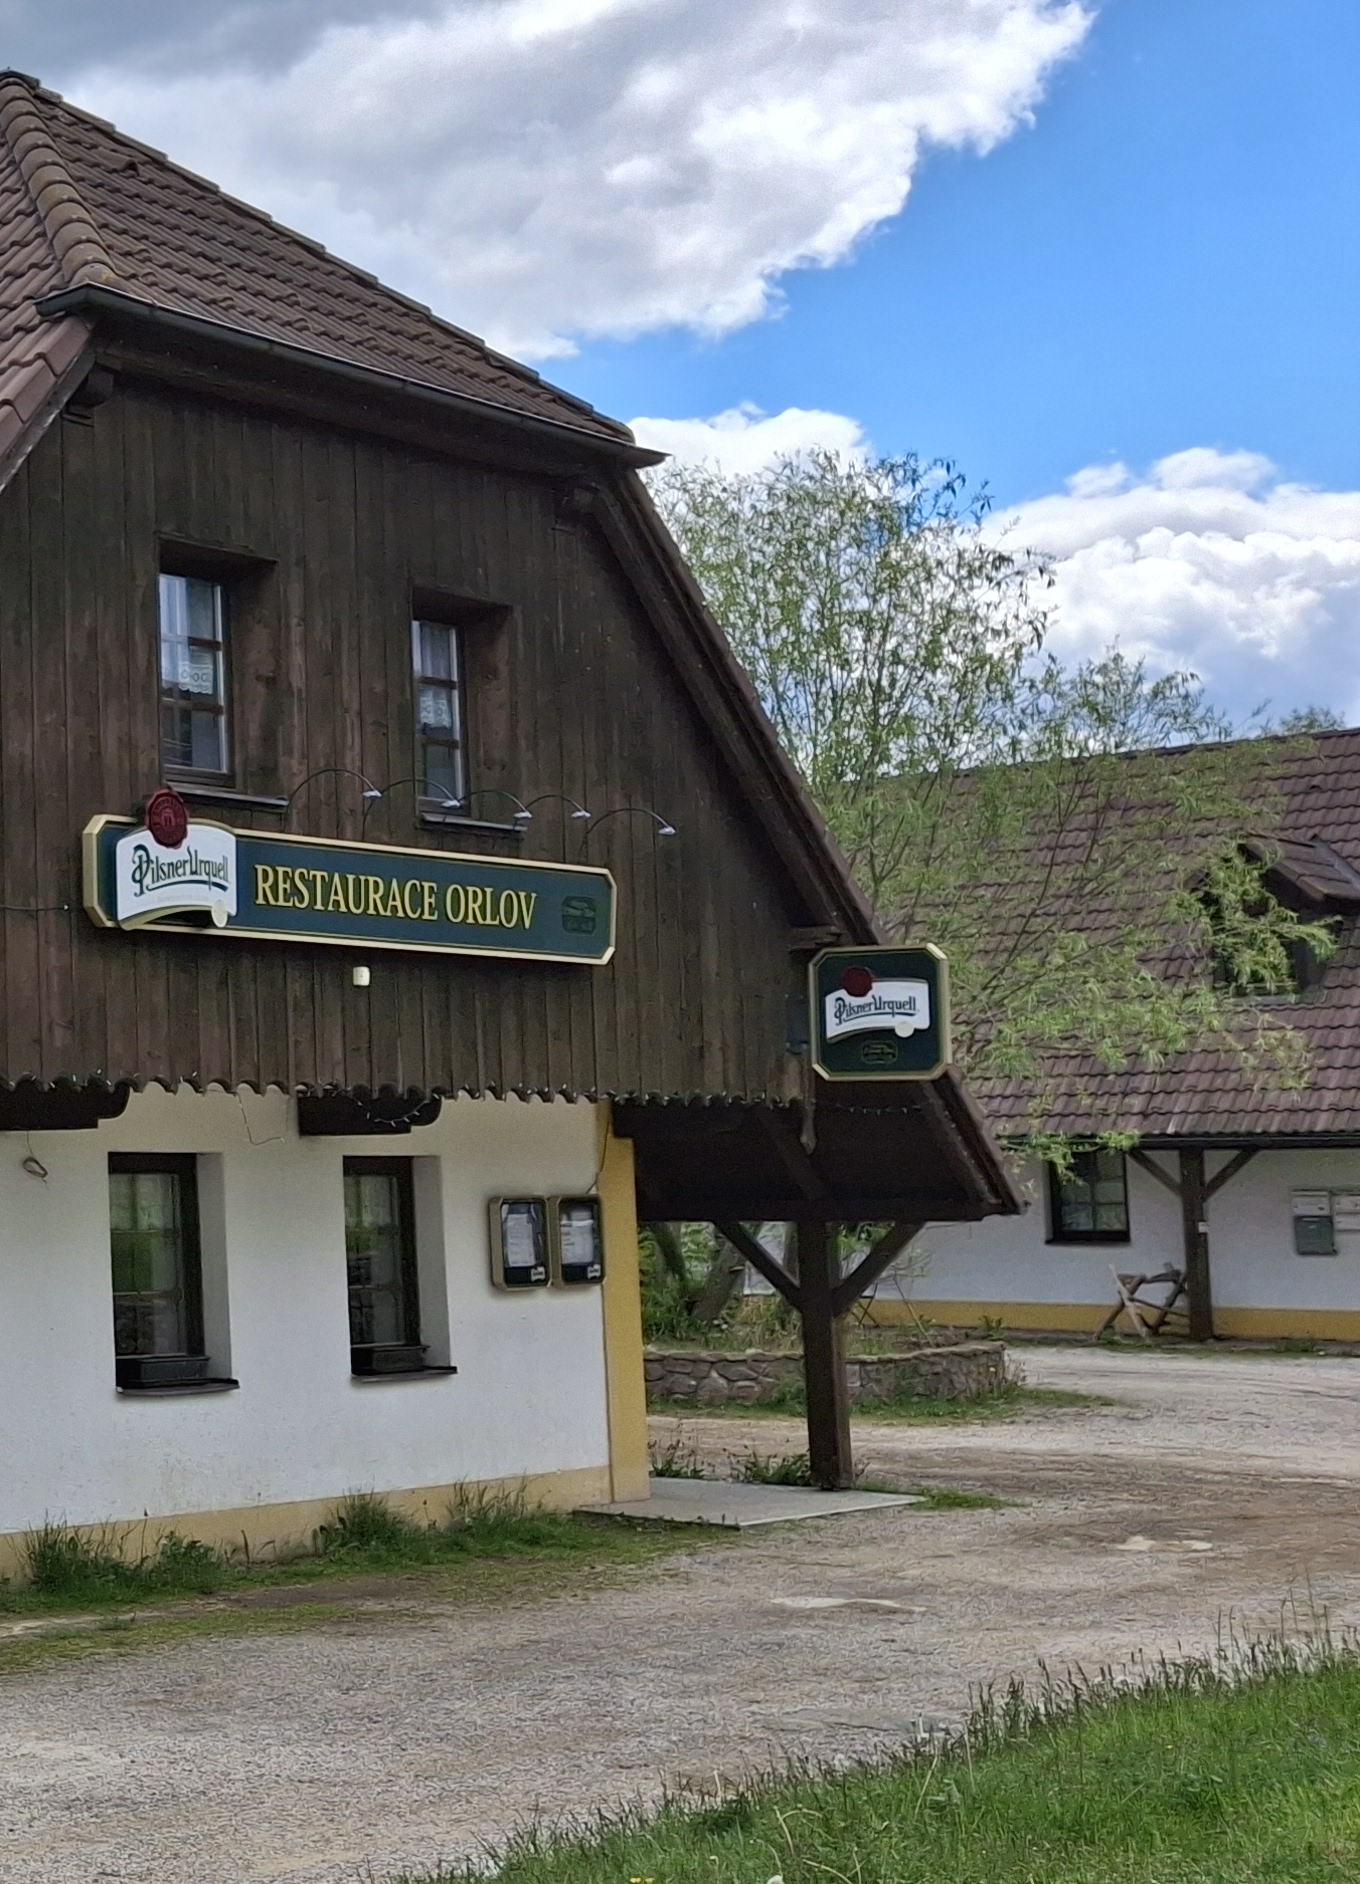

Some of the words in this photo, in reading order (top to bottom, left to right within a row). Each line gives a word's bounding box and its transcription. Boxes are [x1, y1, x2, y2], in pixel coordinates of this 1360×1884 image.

[131, 843, 188, 897] Pilsner
[187, 846, 229, 890] Urquell
[254, 864, 439, 922] RESTAURACE
[445, 883, 538, 930] ORLOV
[834, 996, 875, 1026] Pilsner
[872, 994, 917, 1018] Urquell
